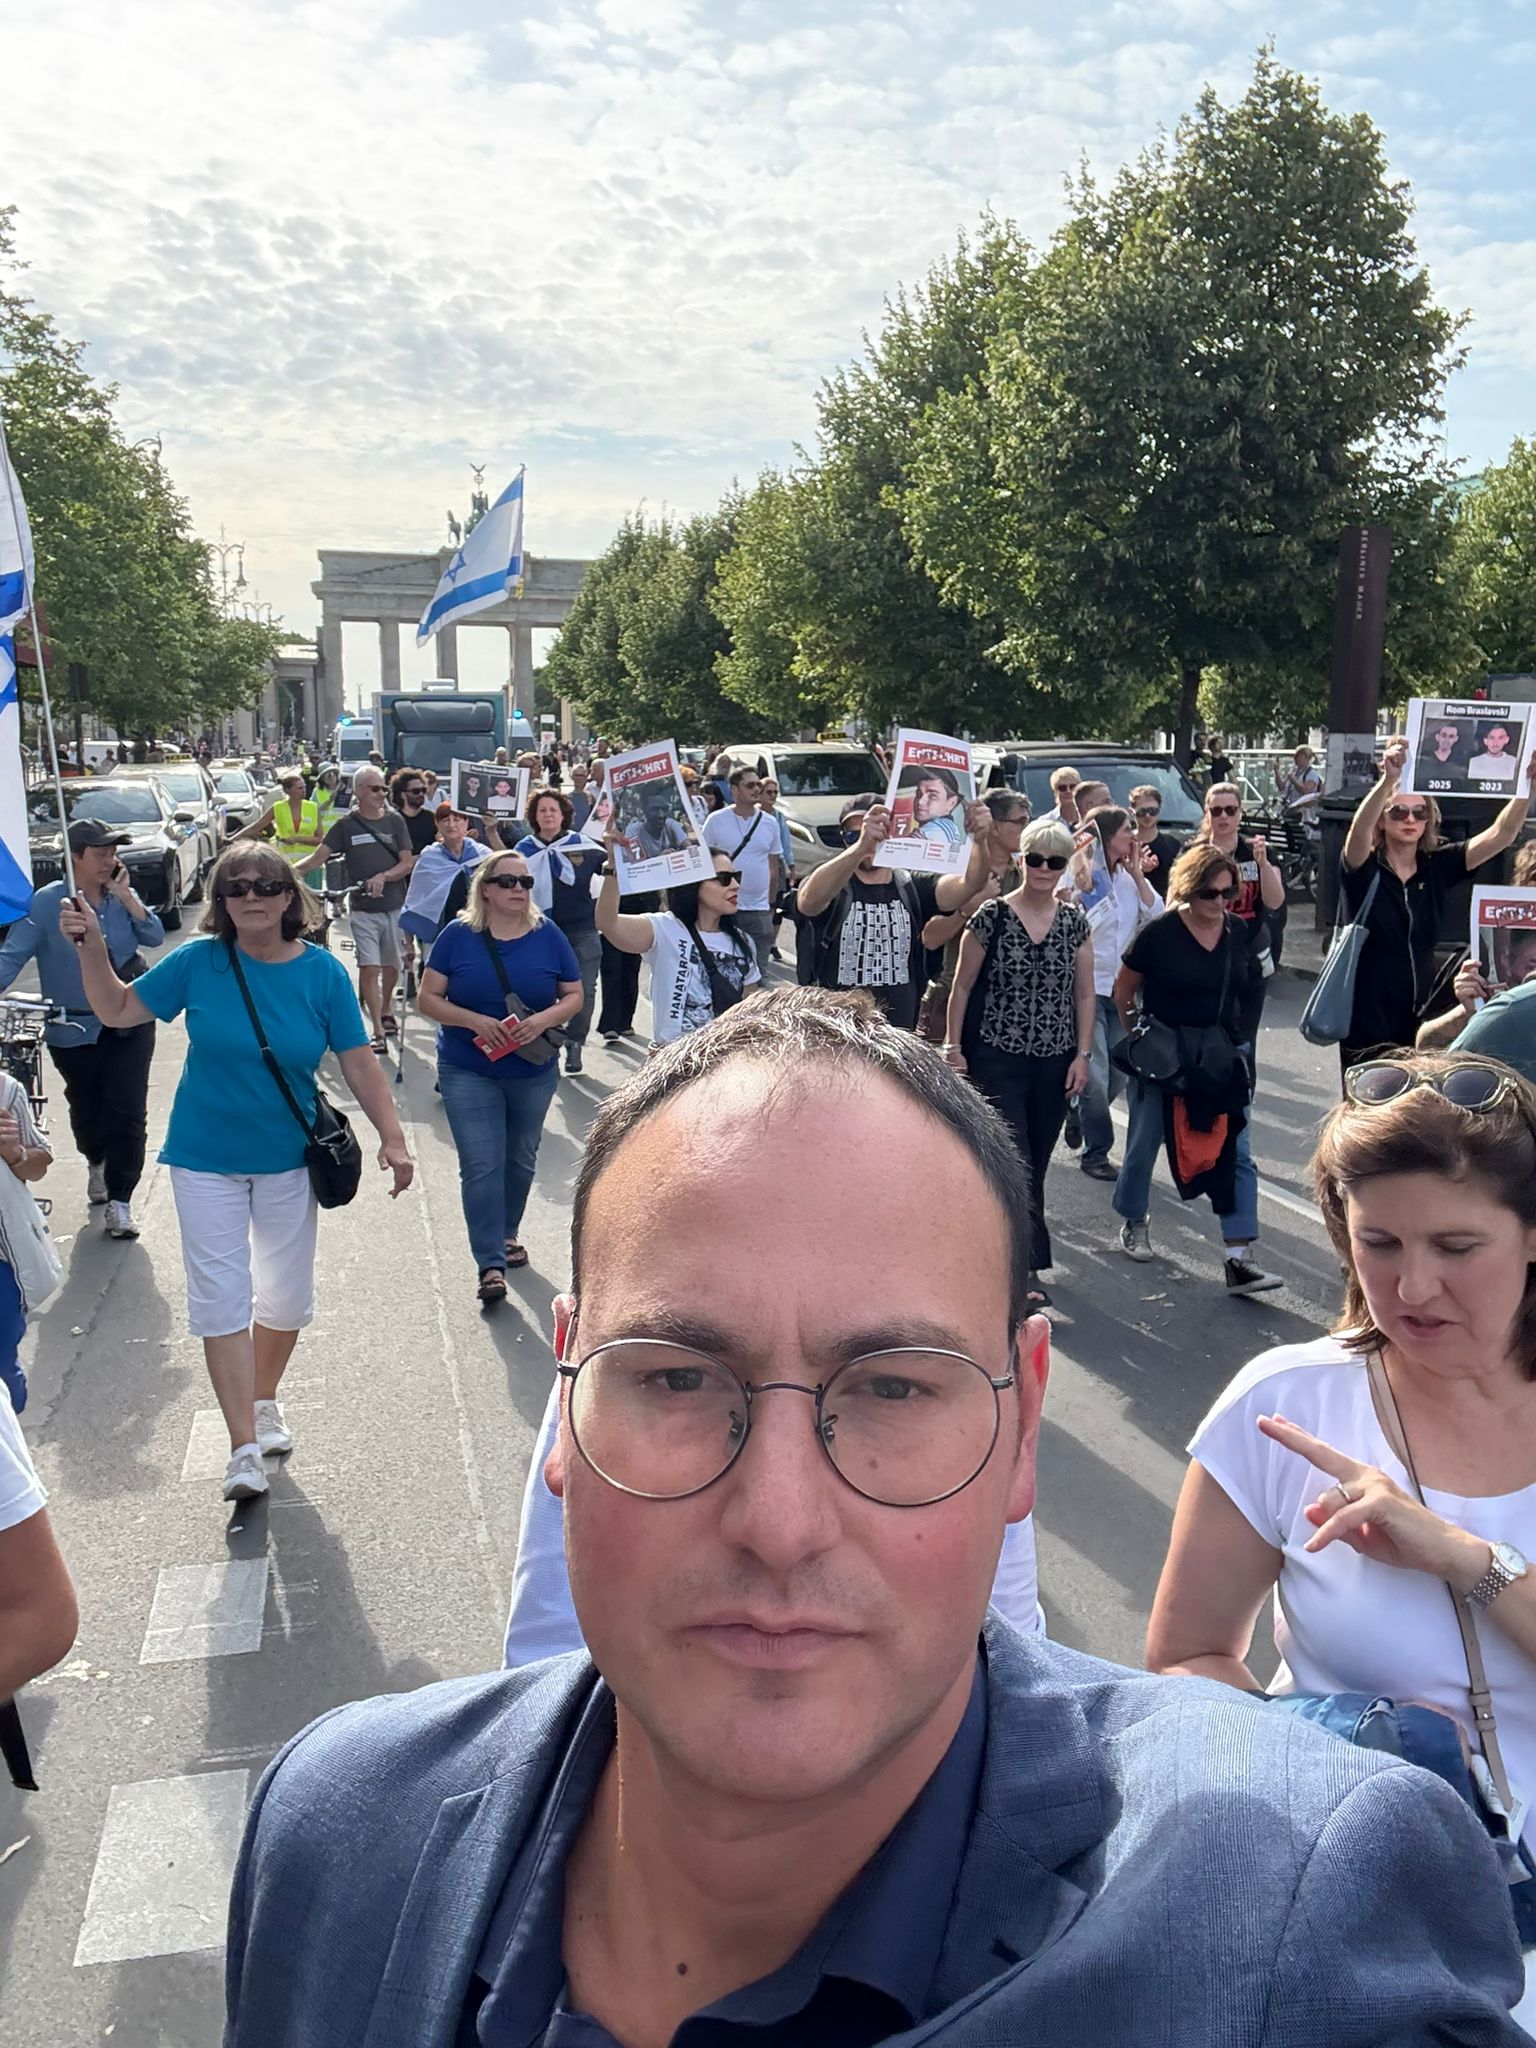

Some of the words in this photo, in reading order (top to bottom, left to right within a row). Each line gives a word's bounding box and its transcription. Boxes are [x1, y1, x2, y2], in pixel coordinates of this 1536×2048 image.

[1446, 705, 1465, 715] Rom
[1467, 706, 1509, 717] Braslavski
[1428, 779, 1451, 790] 2025
[1479, 781, 1503, 792] 2023
[897, 823, 907, 836] 7
